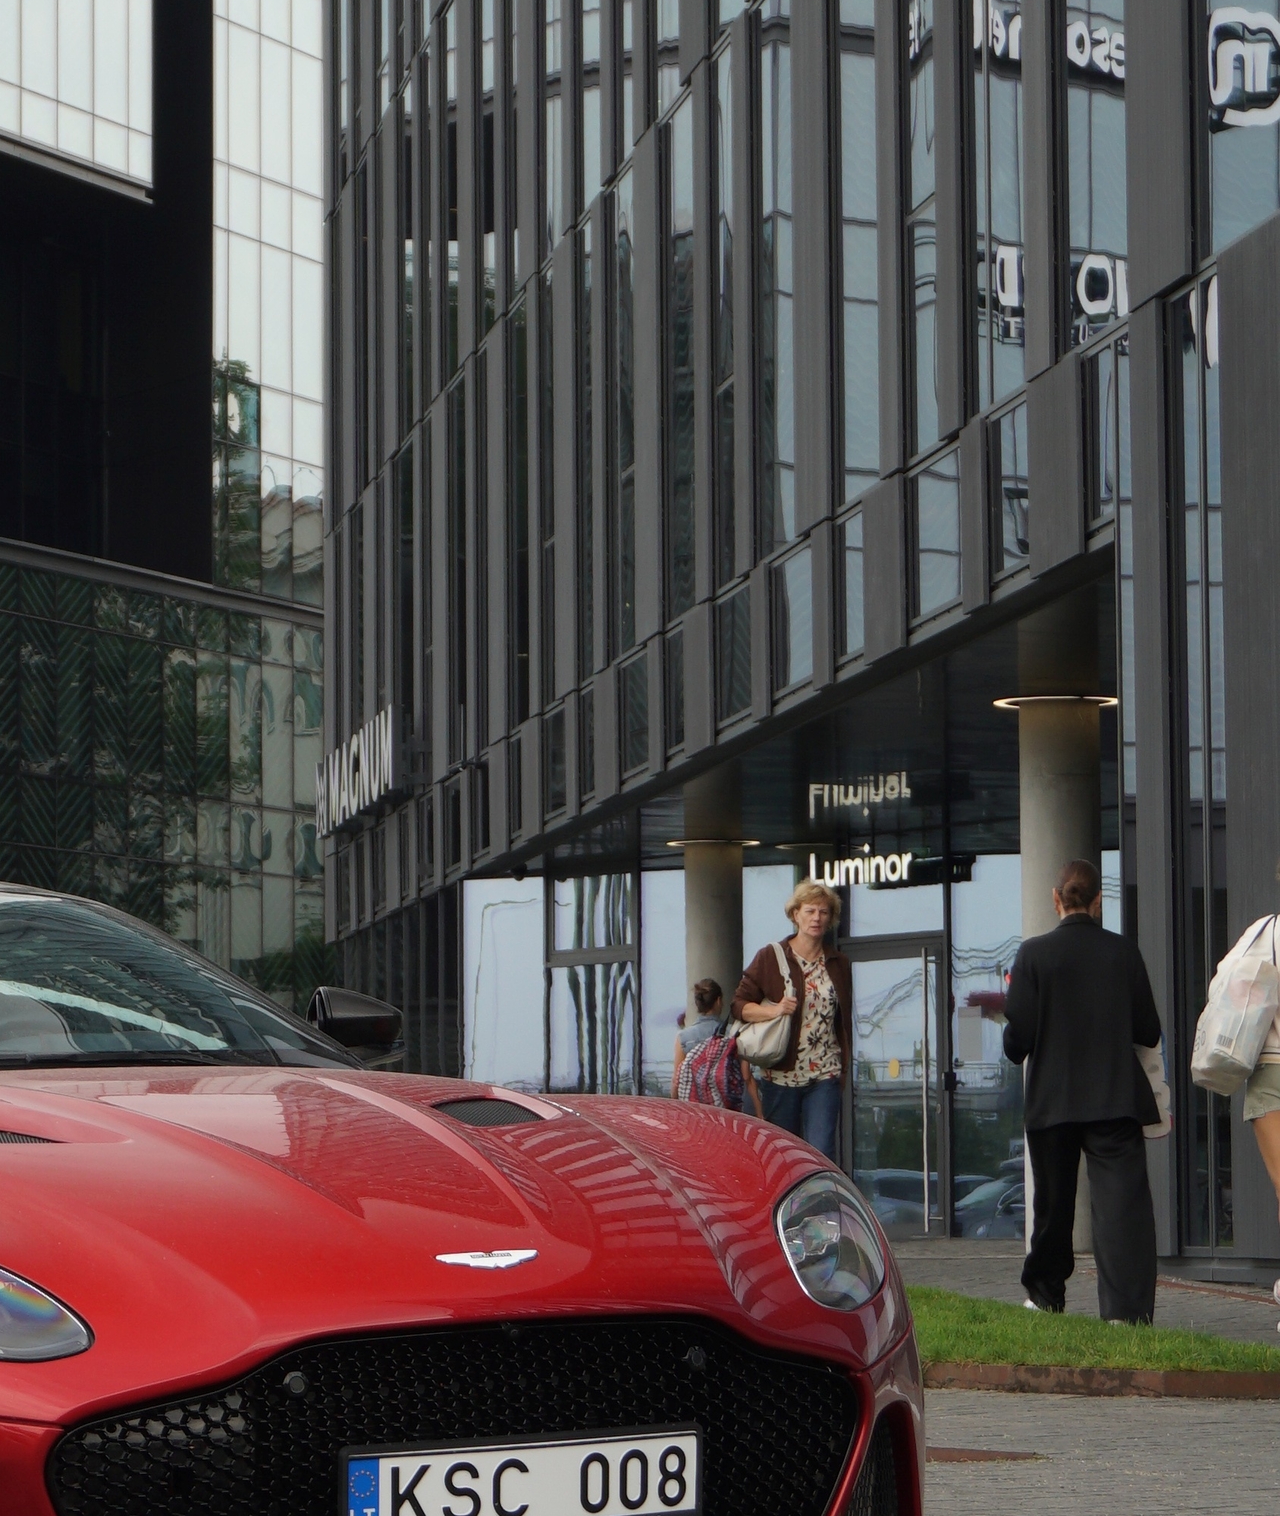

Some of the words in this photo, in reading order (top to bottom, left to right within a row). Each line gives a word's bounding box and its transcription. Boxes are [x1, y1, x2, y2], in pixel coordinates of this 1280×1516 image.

[328, 702, 393, 832] MAGNUM
[809, 843, 913, 887] Luminor
[578, 1444, 687, 1514] 008
